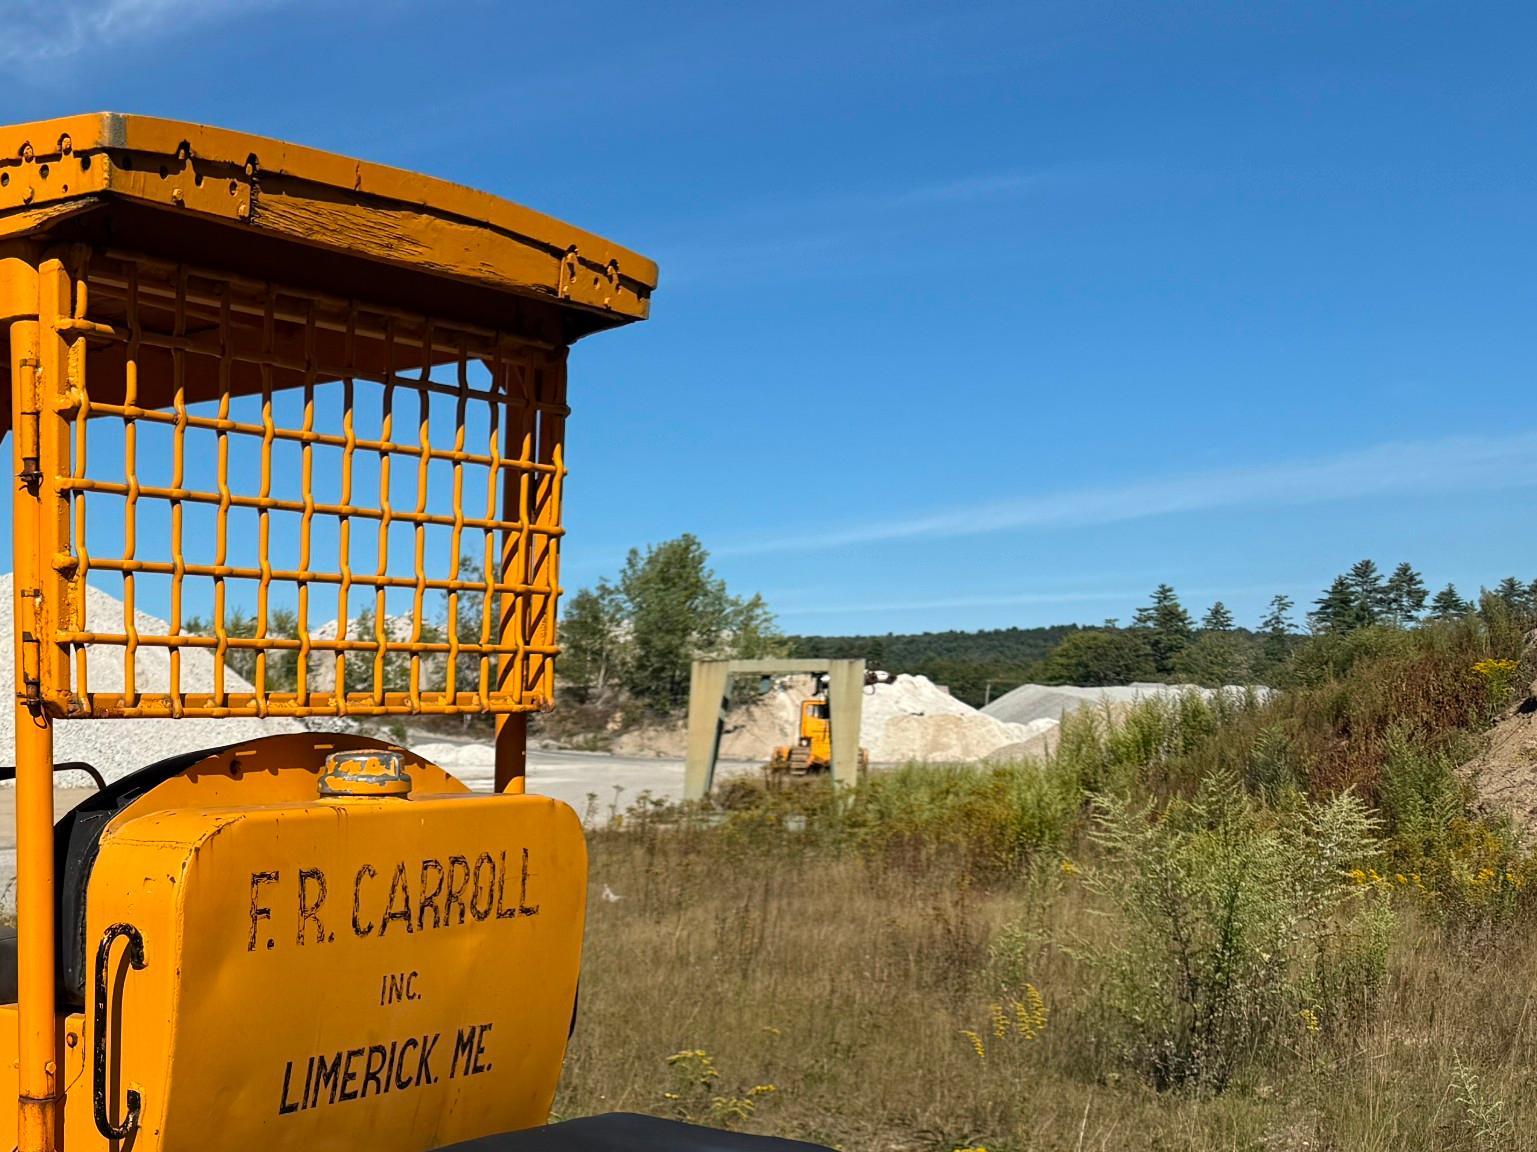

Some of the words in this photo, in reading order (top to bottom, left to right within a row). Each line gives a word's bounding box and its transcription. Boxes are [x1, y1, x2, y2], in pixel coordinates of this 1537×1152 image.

[247, 870, 279, 952] F.
[296, 866, 335, 946] R.
[351, 847, 540, 938] CARROLL
[379, 970, 422, 1006] INC.
[449, 1021, 494, 1079] ME.
